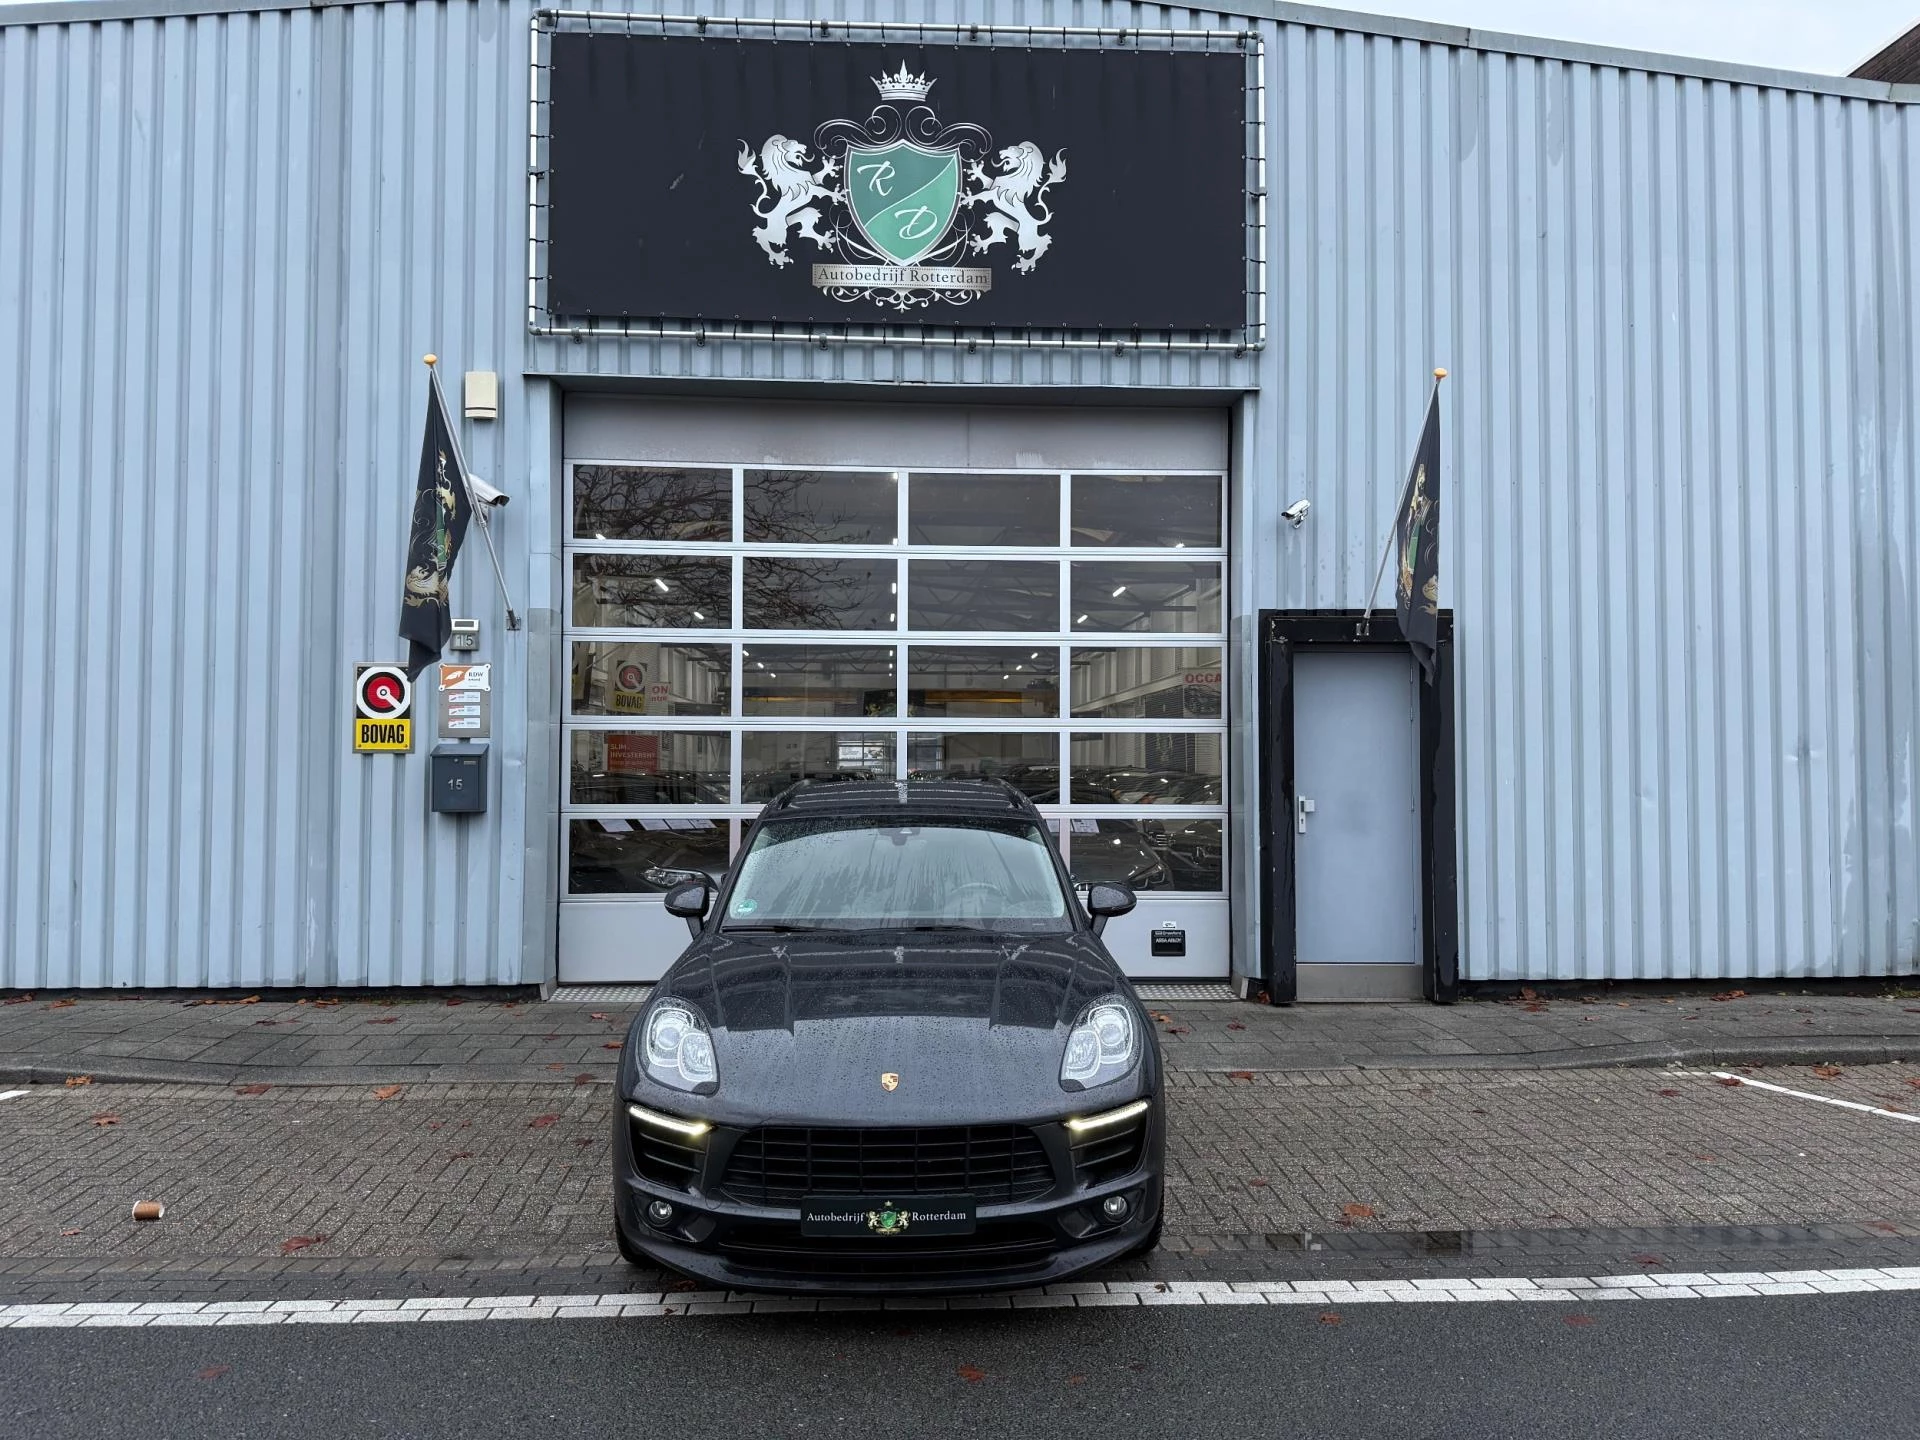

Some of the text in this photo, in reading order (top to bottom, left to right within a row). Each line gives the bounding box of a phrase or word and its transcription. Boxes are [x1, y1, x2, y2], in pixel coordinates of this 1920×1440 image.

[856, 160, 896, 197] R
[894, 205, 939, 240] D
[818, 267, 988, 285] Autobedrijf Rotterdam
[455, 634, 473, 647] 15
[615, 694, 642, 709] BOVAG
[361, 723, 405, 745] BOVAG
[447, 778, 463, 791] 15
[806, 1210, 967, 1224] Autobedrijf Rotterdam
